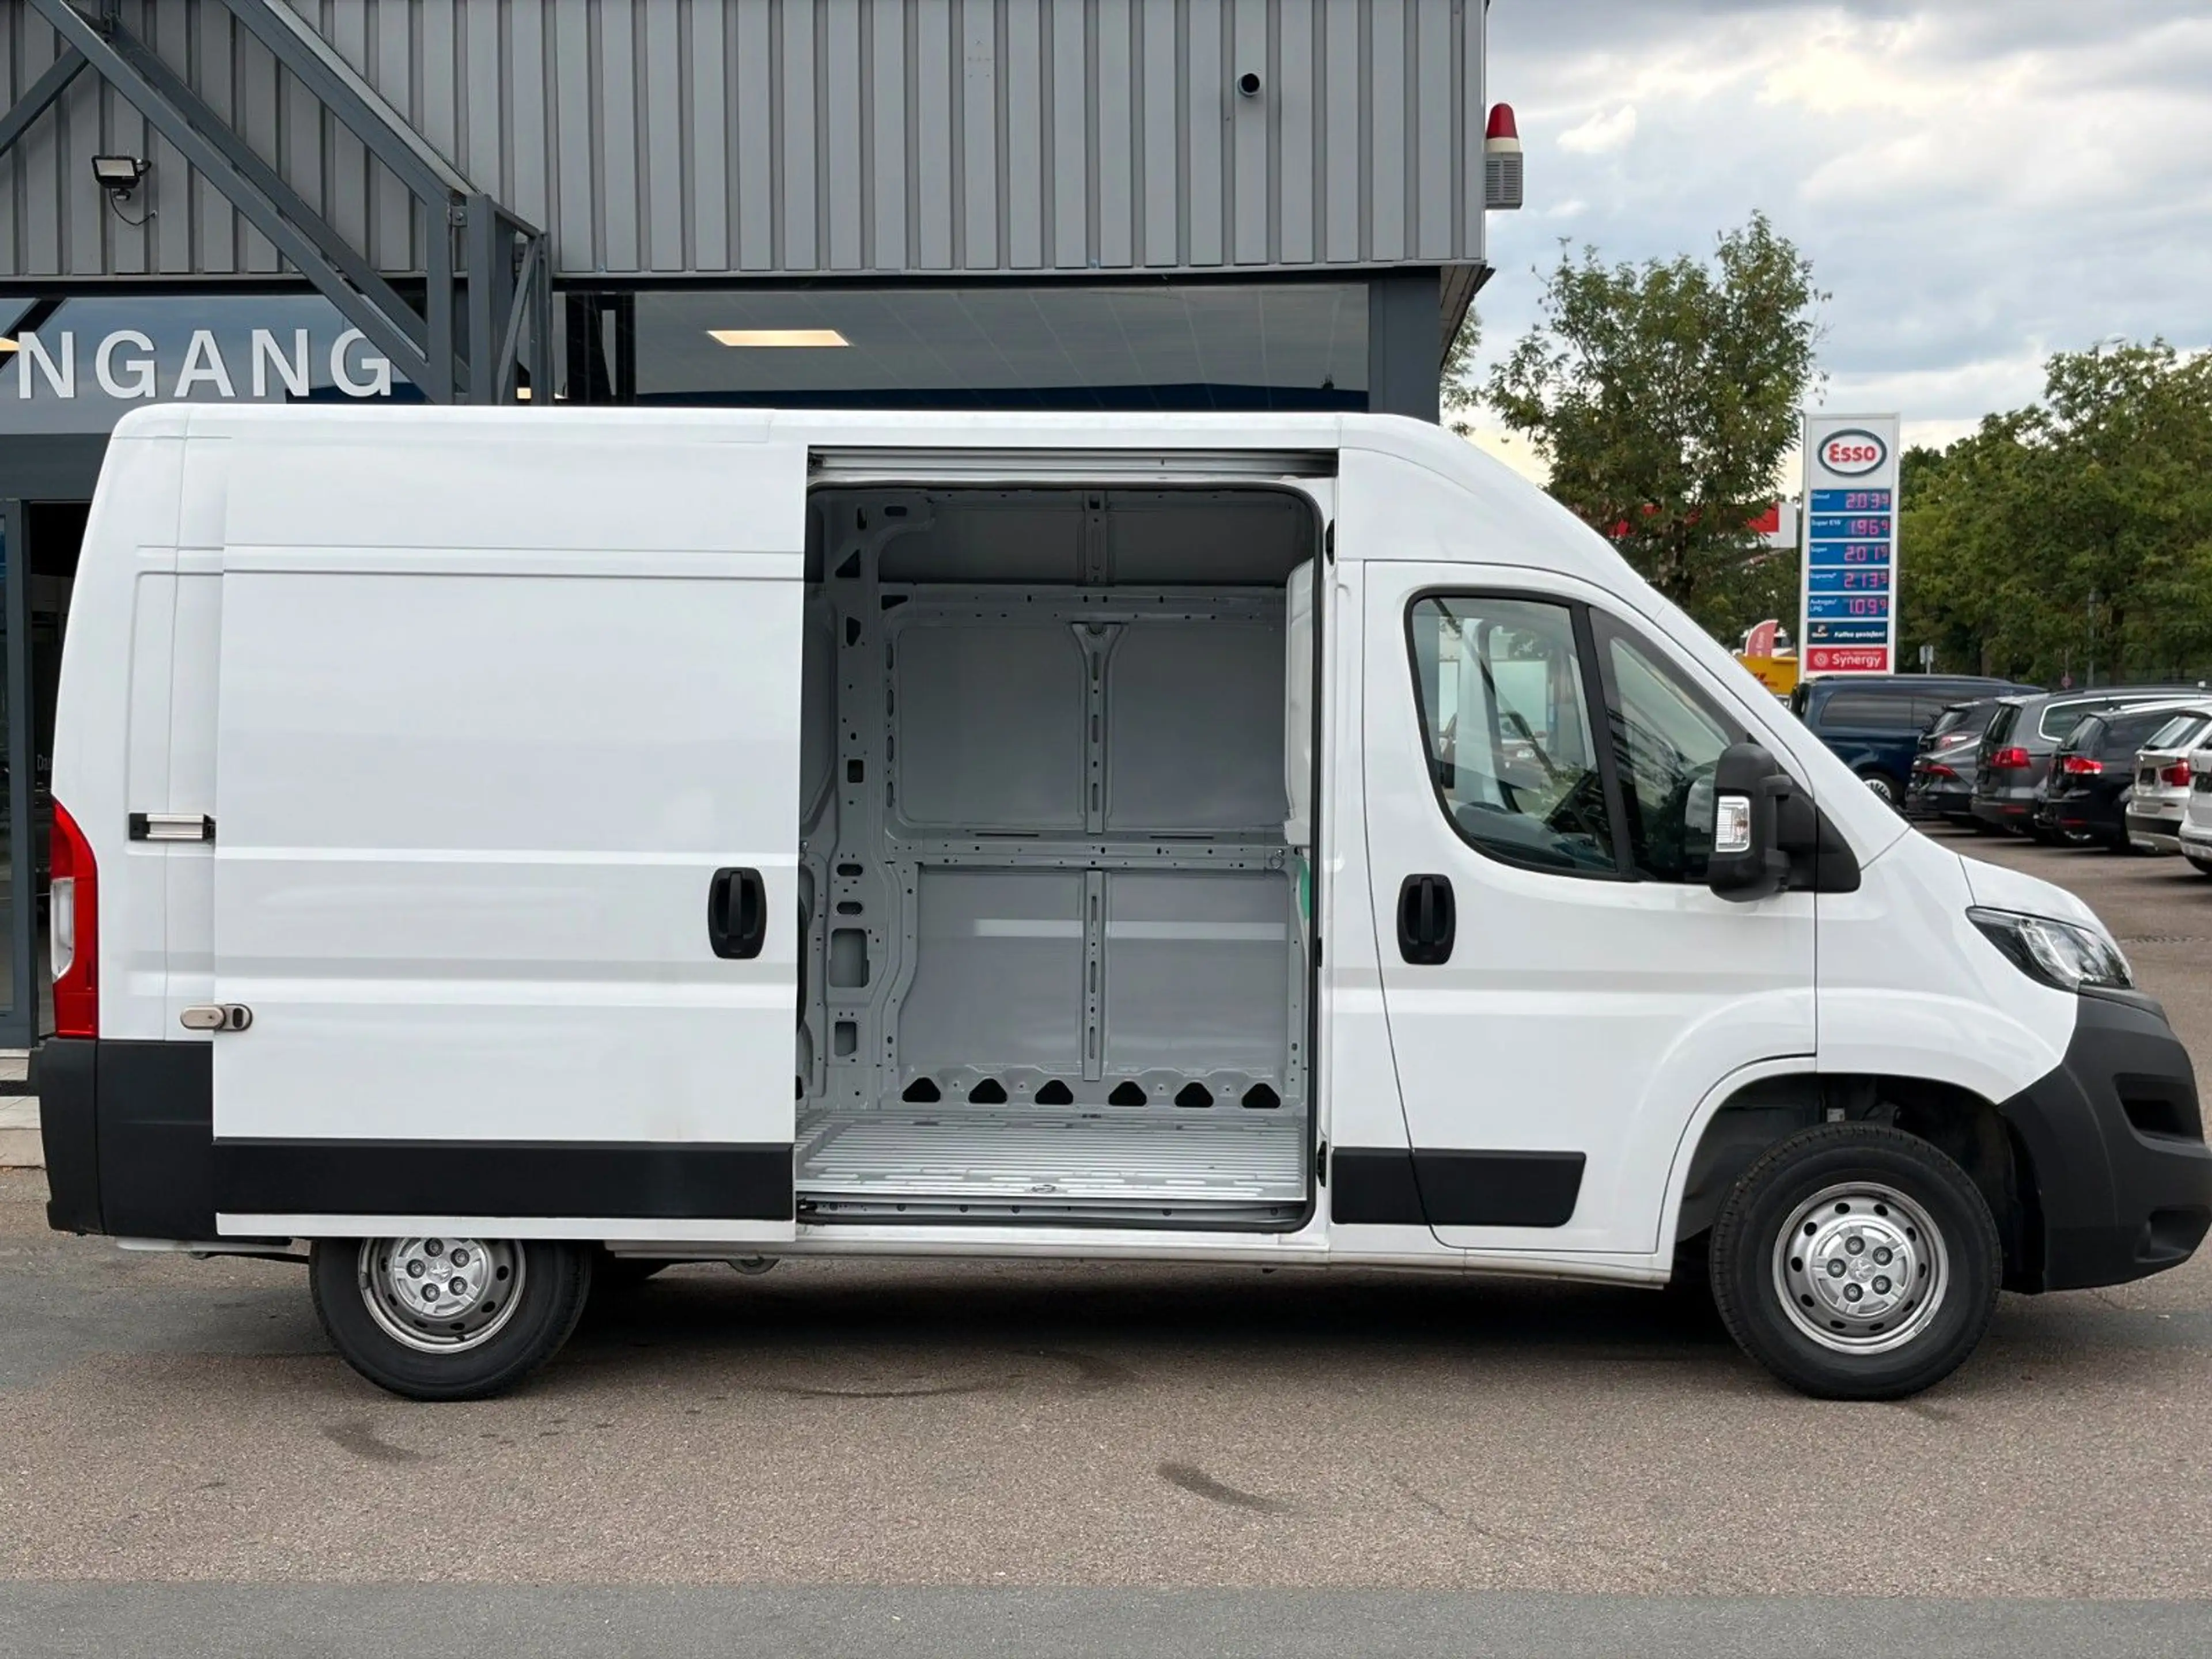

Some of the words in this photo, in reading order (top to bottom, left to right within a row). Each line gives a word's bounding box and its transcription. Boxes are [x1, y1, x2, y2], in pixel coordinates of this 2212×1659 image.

[18, 329, 392, 399] NGANG
[1828, 442, 1877, 462] Esso
[1832, 653, 1881, 668] Synergy
